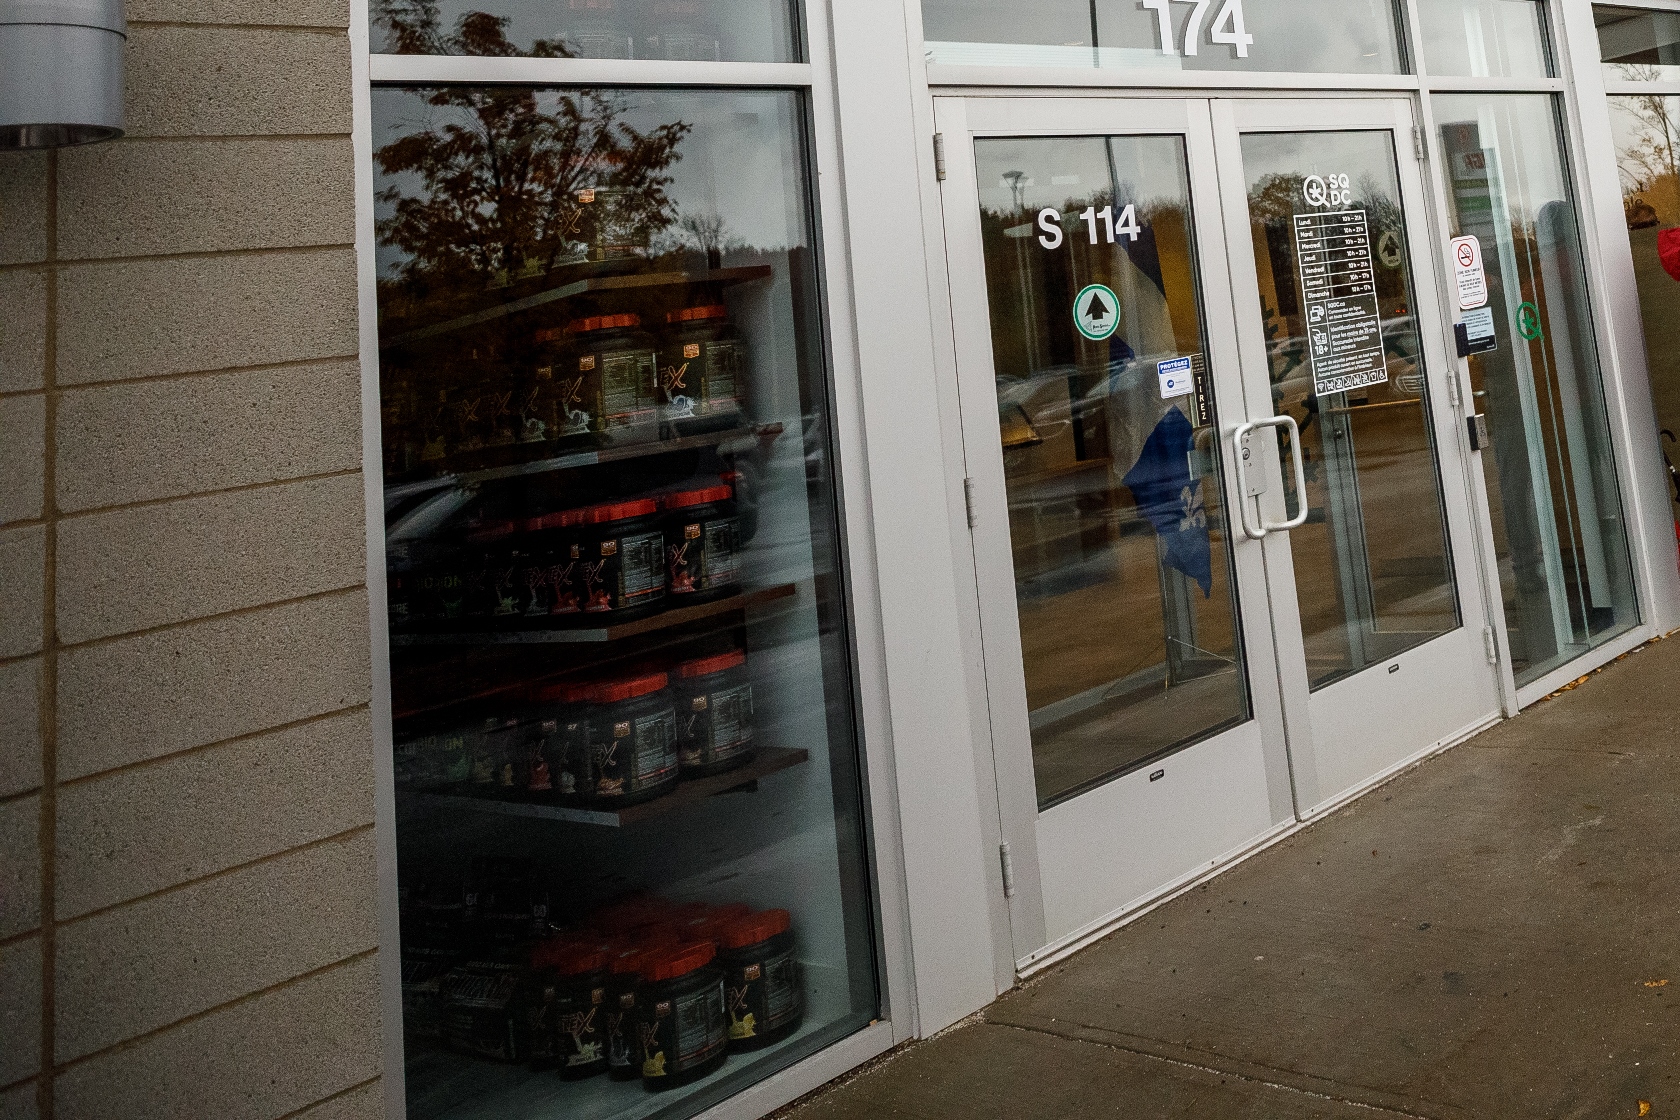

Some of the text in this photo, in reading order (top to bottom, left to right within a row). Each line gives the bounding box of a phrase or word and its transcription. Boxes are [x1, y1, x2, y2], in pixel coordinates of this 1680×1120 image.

[1037, 204, 1142, 250] S 114
[1315, 345, 1328, 355] 18+
[1160, 359, 1188, 370] PROTÉGEZ
[1197, 376, 1207, 420] TIREZ
